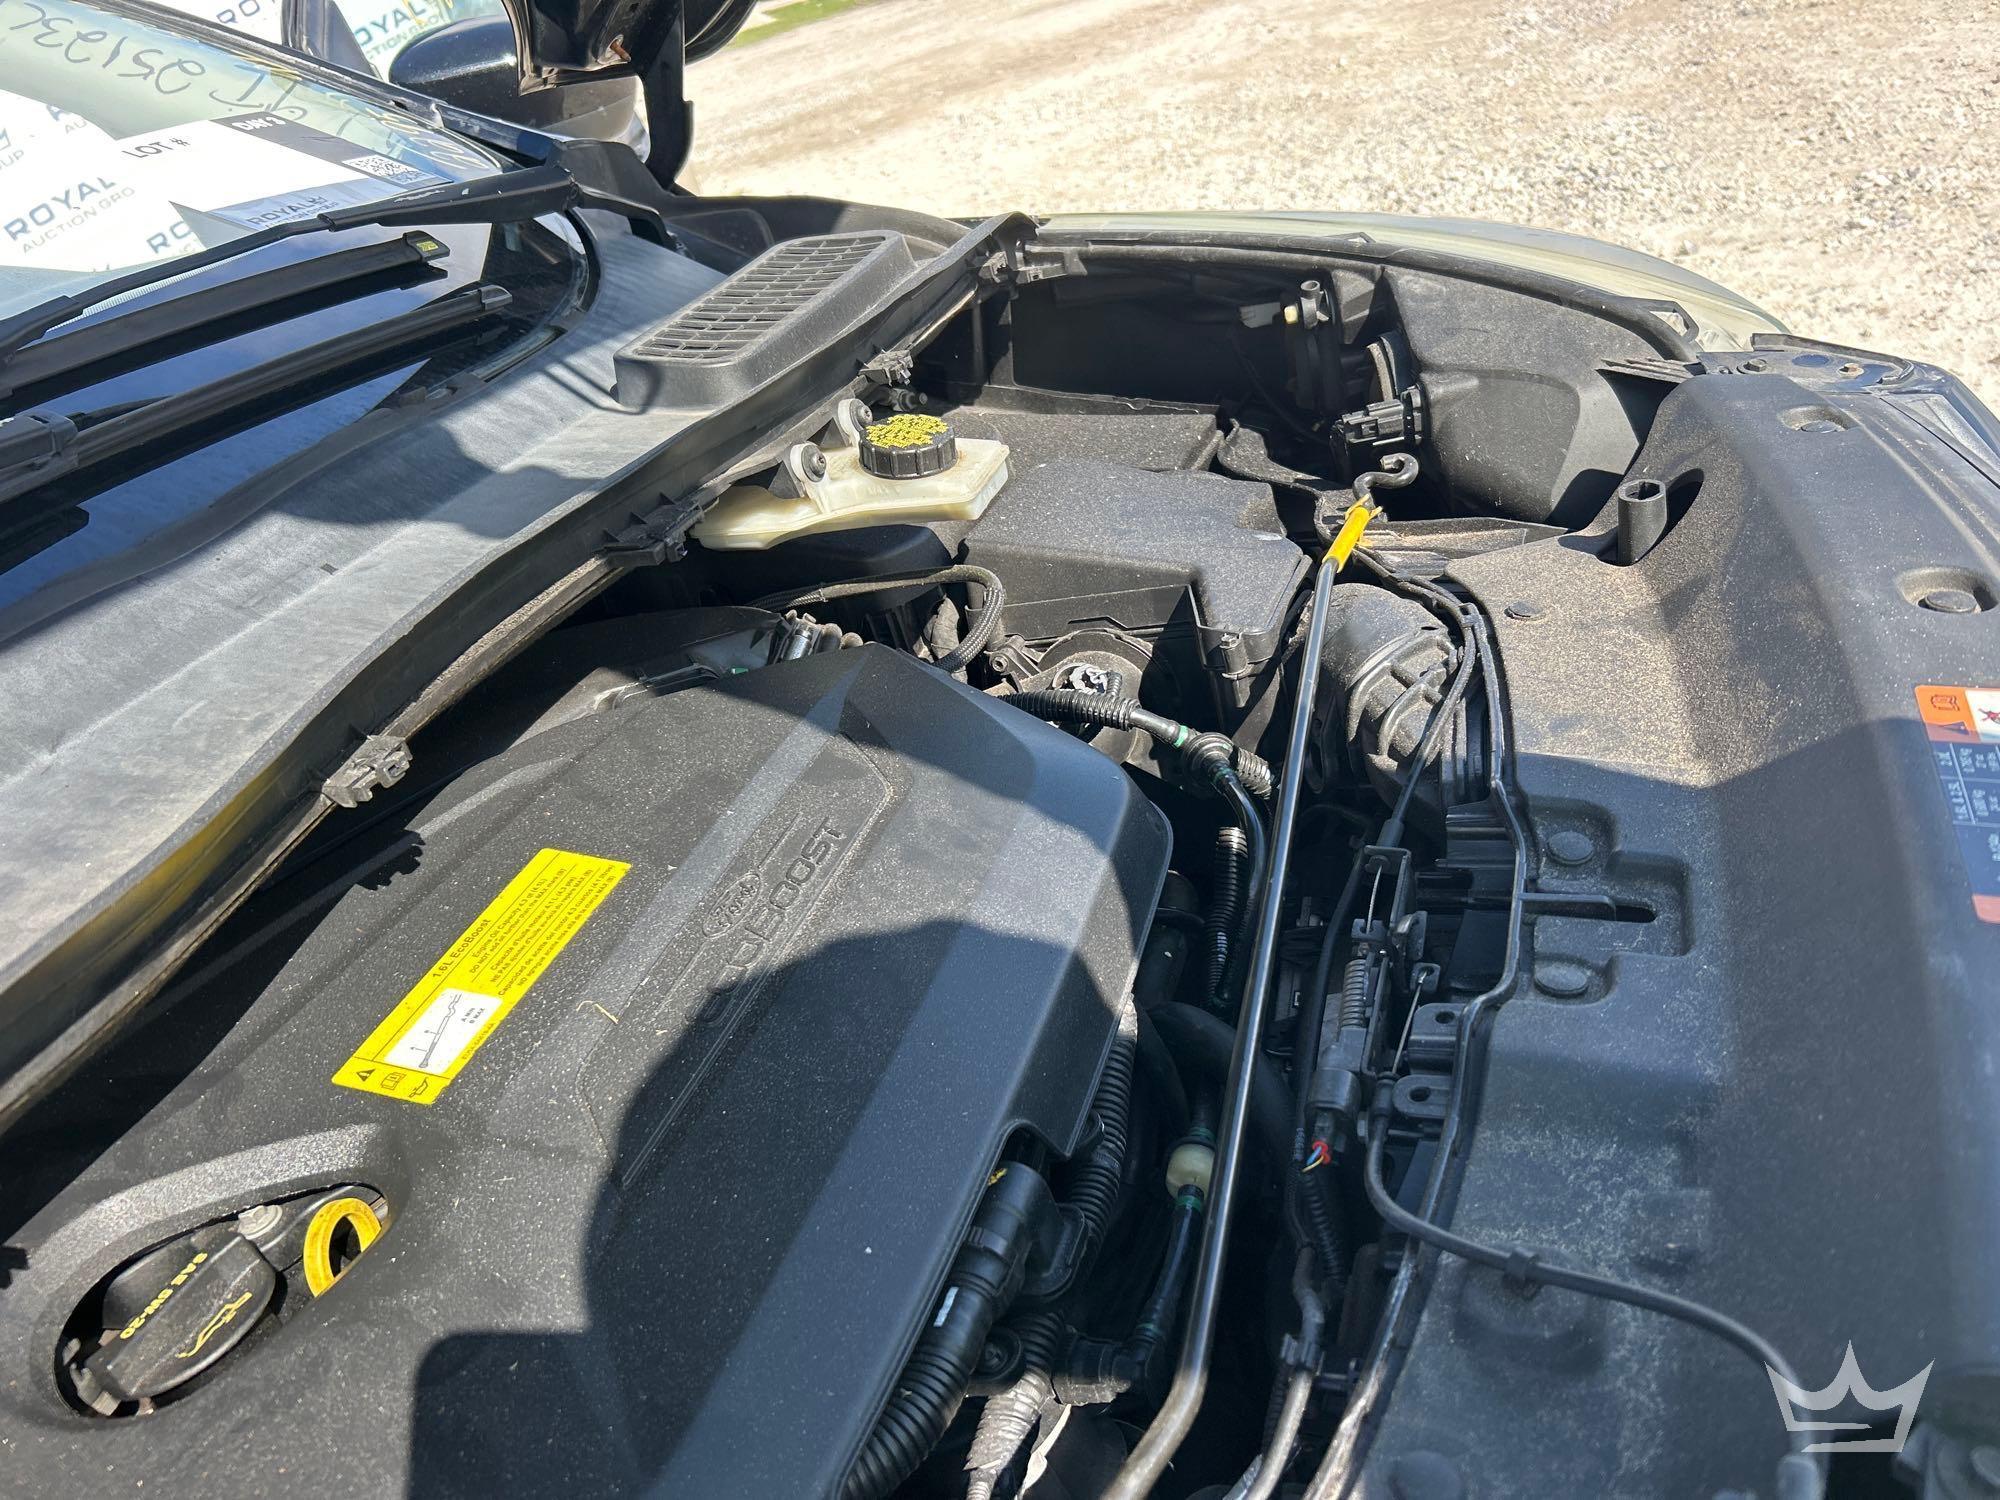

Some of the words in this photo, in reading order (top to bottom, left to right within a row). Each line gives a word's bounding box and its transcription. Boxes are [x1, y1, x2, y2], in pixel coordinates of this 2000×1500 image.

[232, 118, 273, 131] DAY
[121, 141, 173, 159] LOT
[169, 138, 190, 147] #
[3, 177, 117, 242] ROYAL
[247, 199, 313, 226] ROYAL
[22, 208, 98, 254] AUCTION
[430, 959, 454, 978] 1.6L
[449, 918, 491, 958] EcoBoost
